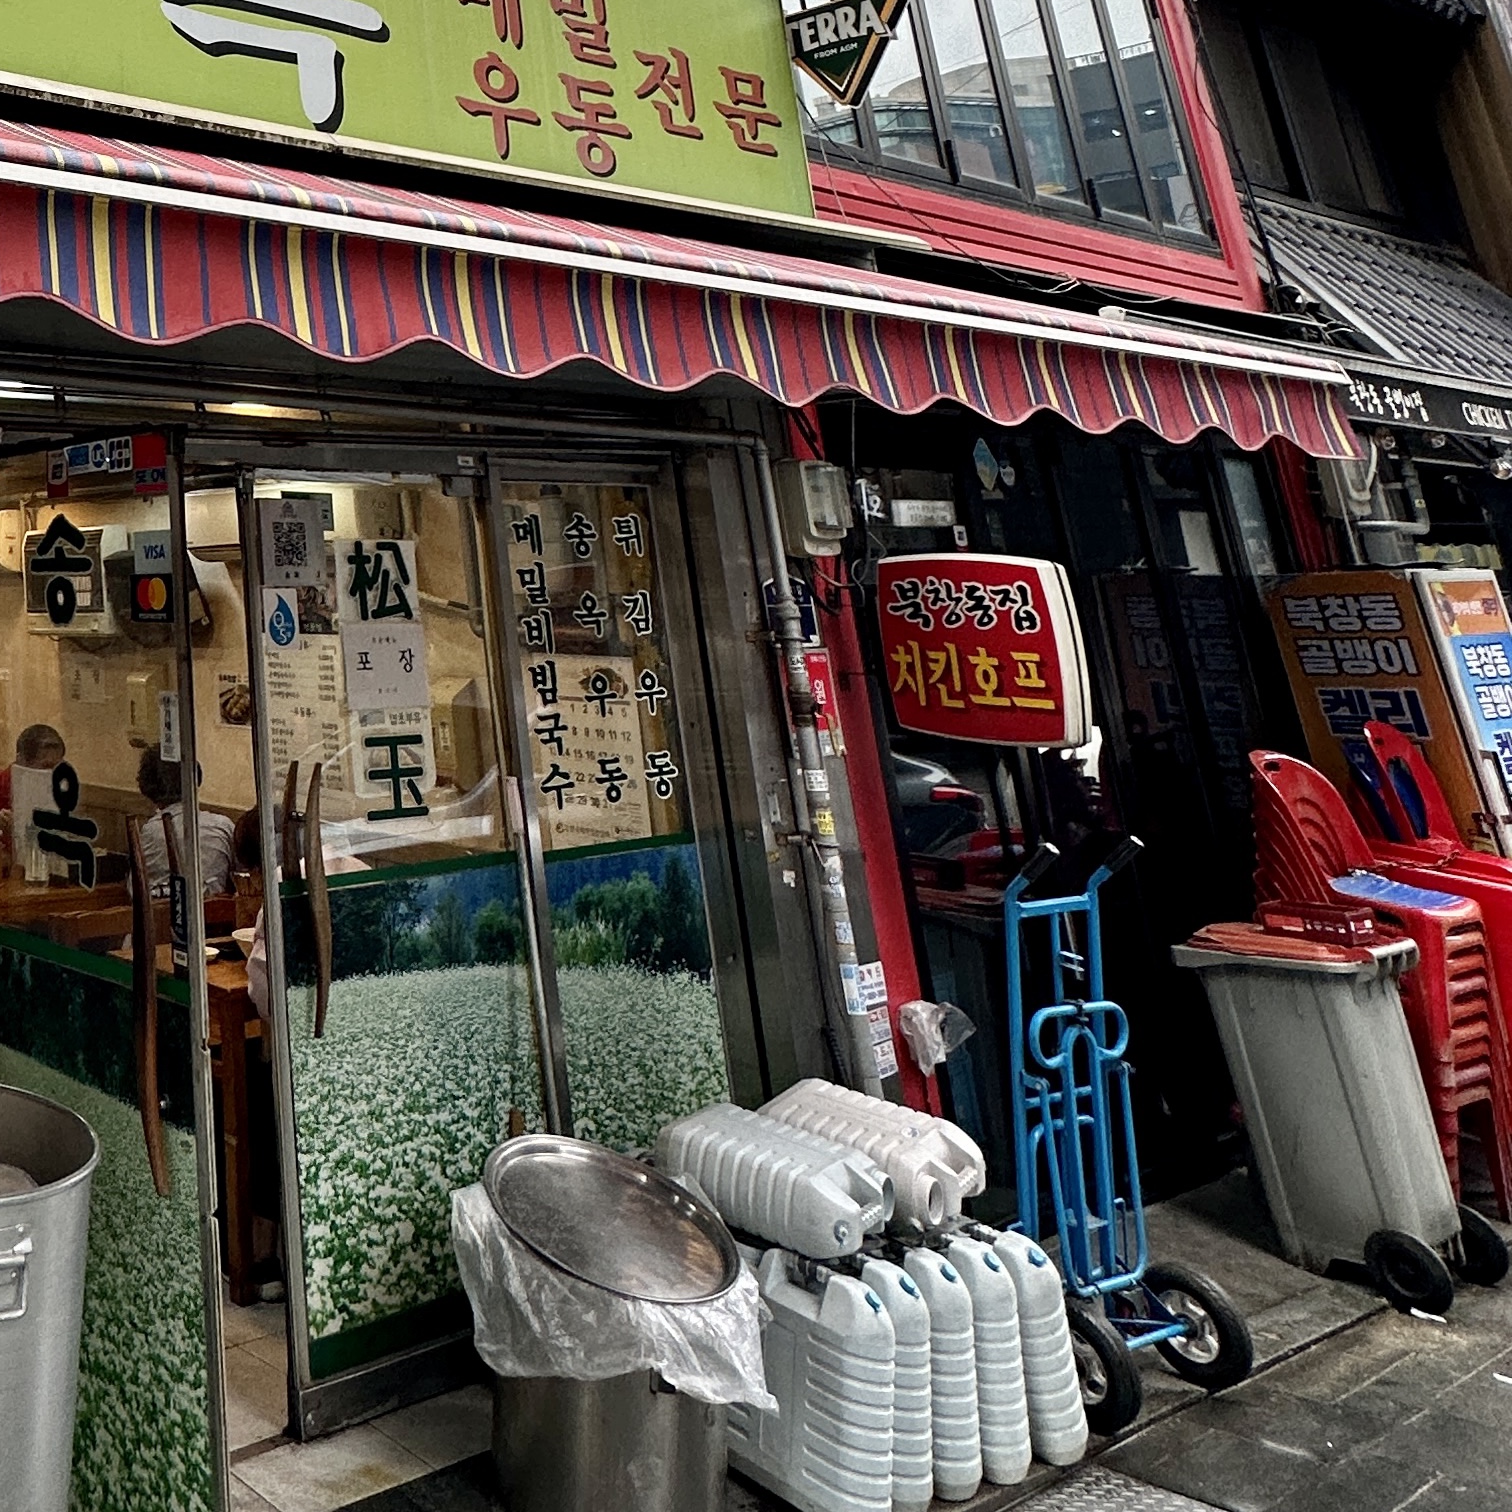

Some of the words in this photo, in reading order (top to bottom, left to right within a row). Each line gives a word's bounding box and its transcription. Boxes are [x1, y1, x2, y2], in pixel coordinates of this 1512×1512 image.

[454, 50, 633, 178] 우동
[632, 46, 783, 158] 전문
[144, 544, 166, 560] VISA
[1283, 594, 1403, 633] 북창동
[511, 513, 576, 810] 메밀비빔국수
[612, 514, 679, 800] 튀김우동
[890, 639, 1056, 710] 치킨호프
[1295, 638, 1419, 676] 골뱅이
